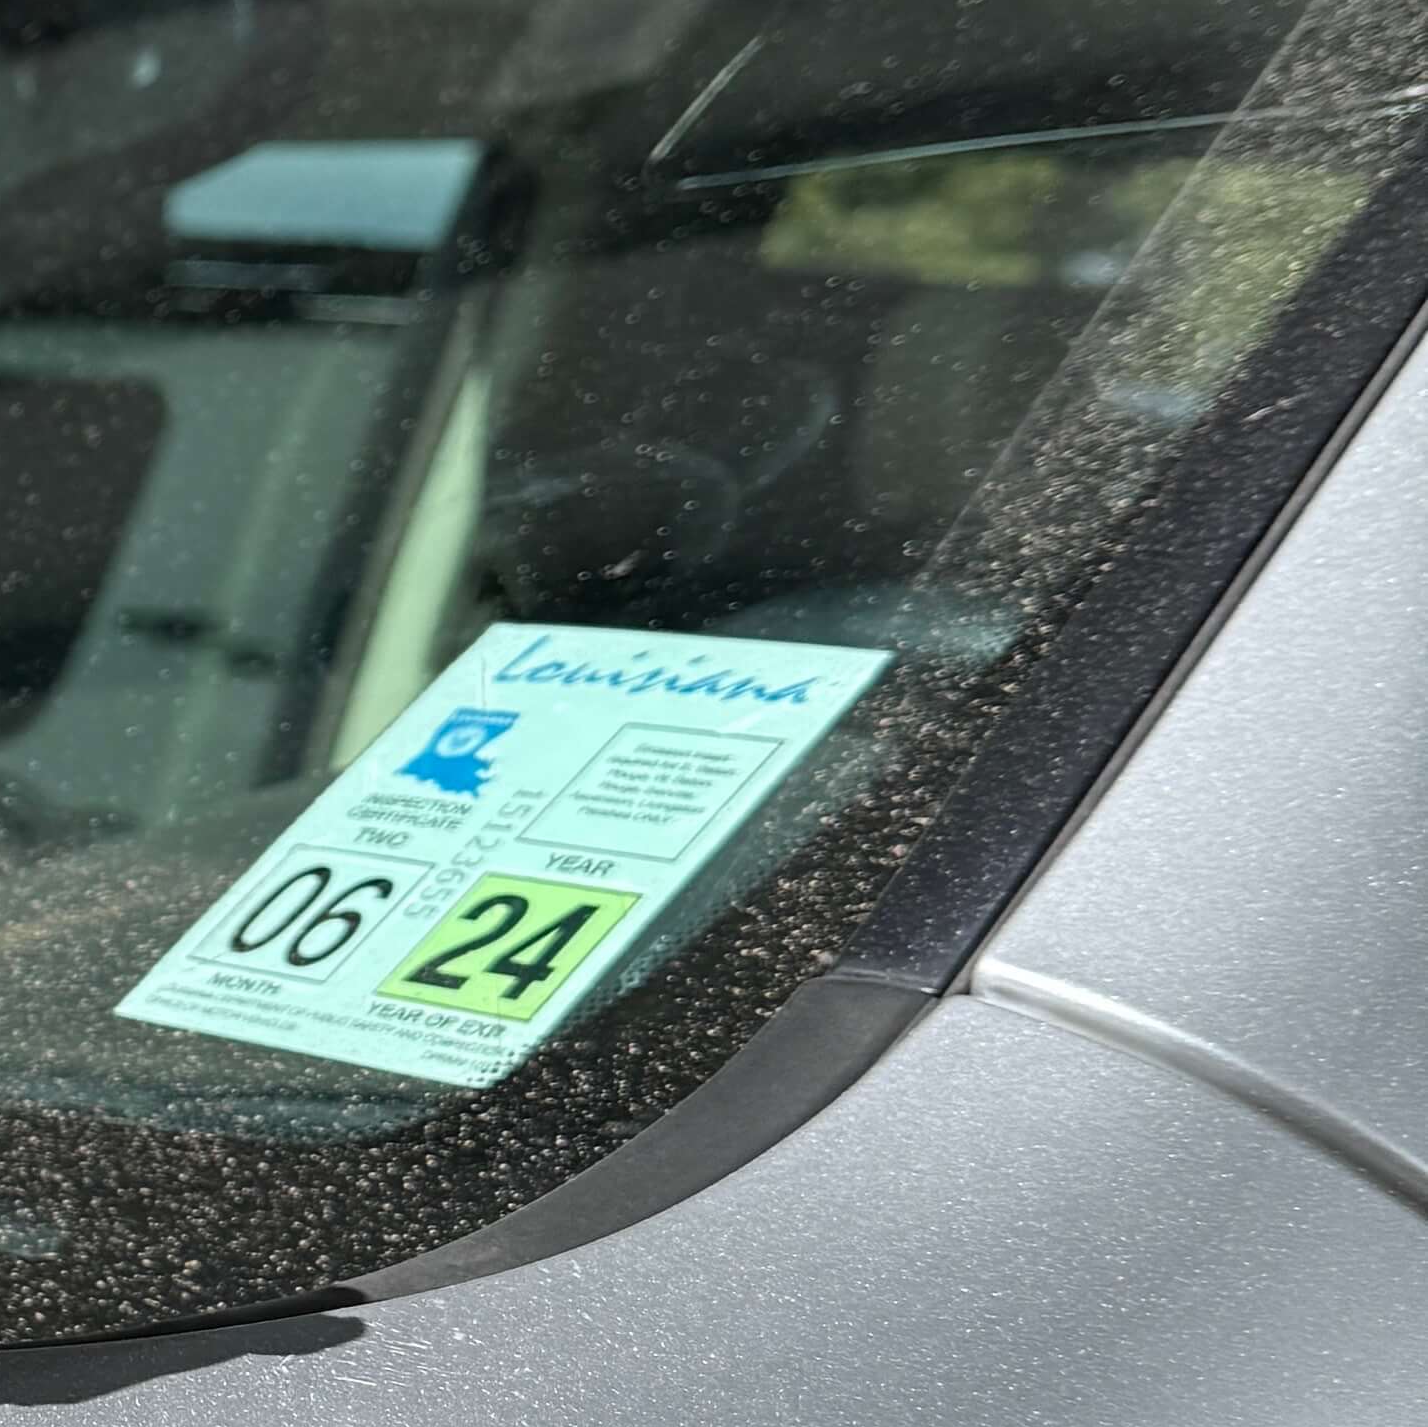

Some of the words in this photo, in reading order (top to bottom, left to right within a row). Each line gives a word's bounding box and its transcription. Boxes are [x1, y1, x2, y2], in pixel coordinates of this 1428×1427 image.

[493, 634, 821, 704] Louisiana
[354, 826, 410, 847] TWO
[545, 852, 615, 876] YEAR
[228, 866, 394, 966] 06
[401, 894, 601, 1000] 24
[206, 972, 282, 995] MONTH
[367, 1000, 420, 1023] YEAR
[425, 1012, 460, 1029] OF
